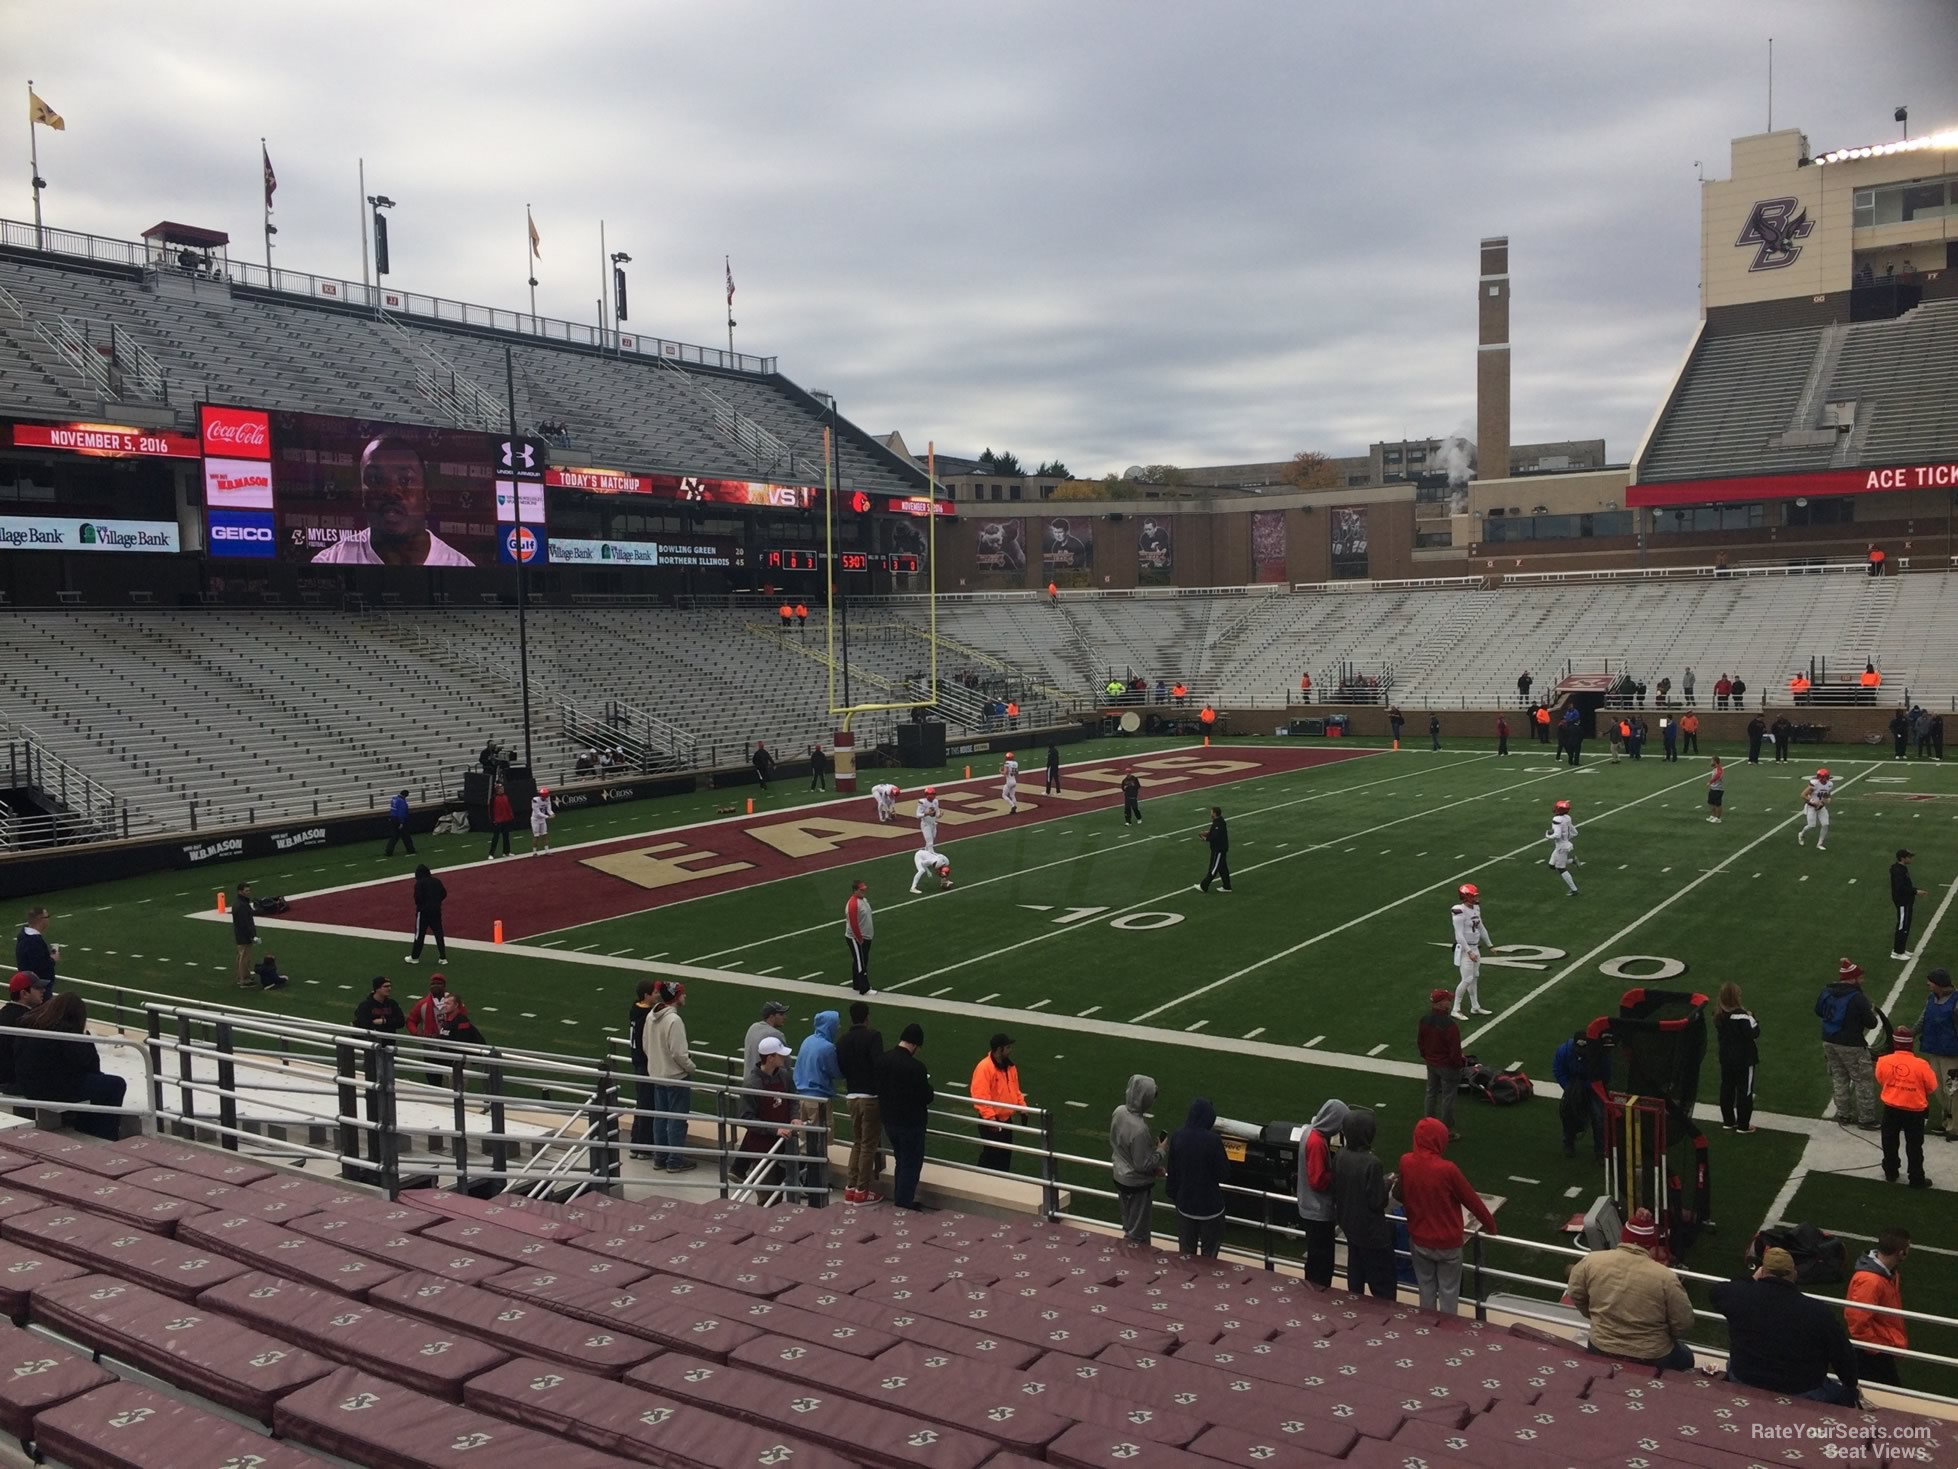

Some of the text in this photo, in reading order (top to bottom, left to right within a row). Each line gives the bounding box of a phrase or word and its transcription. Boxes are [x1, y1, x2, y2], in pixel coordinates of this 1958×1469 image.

[51, 430, 168, 453] NOVEMBER 5, 2016
[560, 472, 640, 491] TODAY'S MATCHUP
[1866, 468, 1907, 489] ACE
[768, 488, 796, 506] VS
[901, 501, 926, 512] NOVEMBER
[28, 528, 63, 545] Bank
[97, 527, 170, 548] Village Bank
[211, 526, 273, 541] GEICO
[308, 528, 369, 543] MYLES WILLIS
[549, 544, 593, 561] Village Bank
[611, 547, 652, 562] Village Bank
[659, 545, 692, 553] BOWLING
[694, 546, 716, 554] GREEN
[659, 556, 697, 565] NORTHERN
[699, 557, 730, 566] ILLINOIS
[276, 828, 326, 849] W.B.MASON
[189, 839, 243, 861] W.B.MASON
